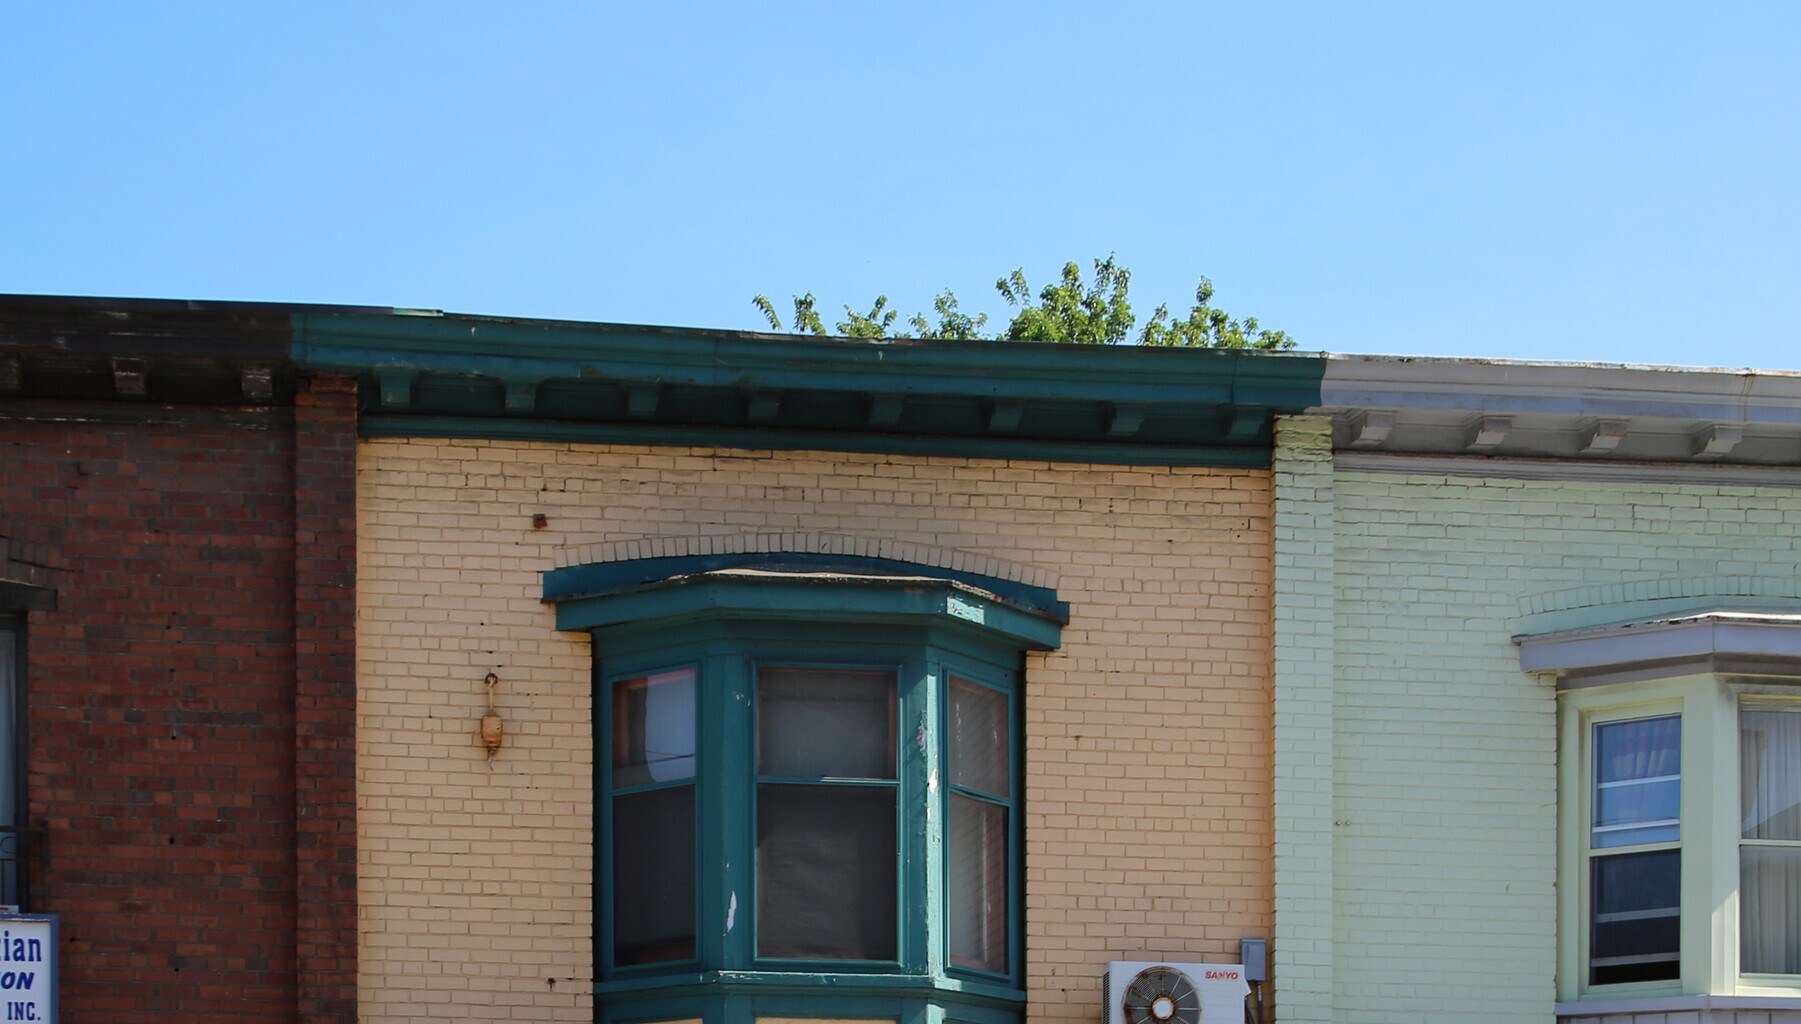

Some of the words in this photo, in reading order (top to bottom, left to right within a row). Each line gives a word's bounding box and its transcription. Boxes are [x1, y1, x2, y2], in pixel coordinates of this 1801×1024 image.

[0, 930, 42, 962] ian
[0, 971, 34, 990] ON
[1205, 971, 1238, 980] SANYO
[7, 1002, 41, 1021] INC.
